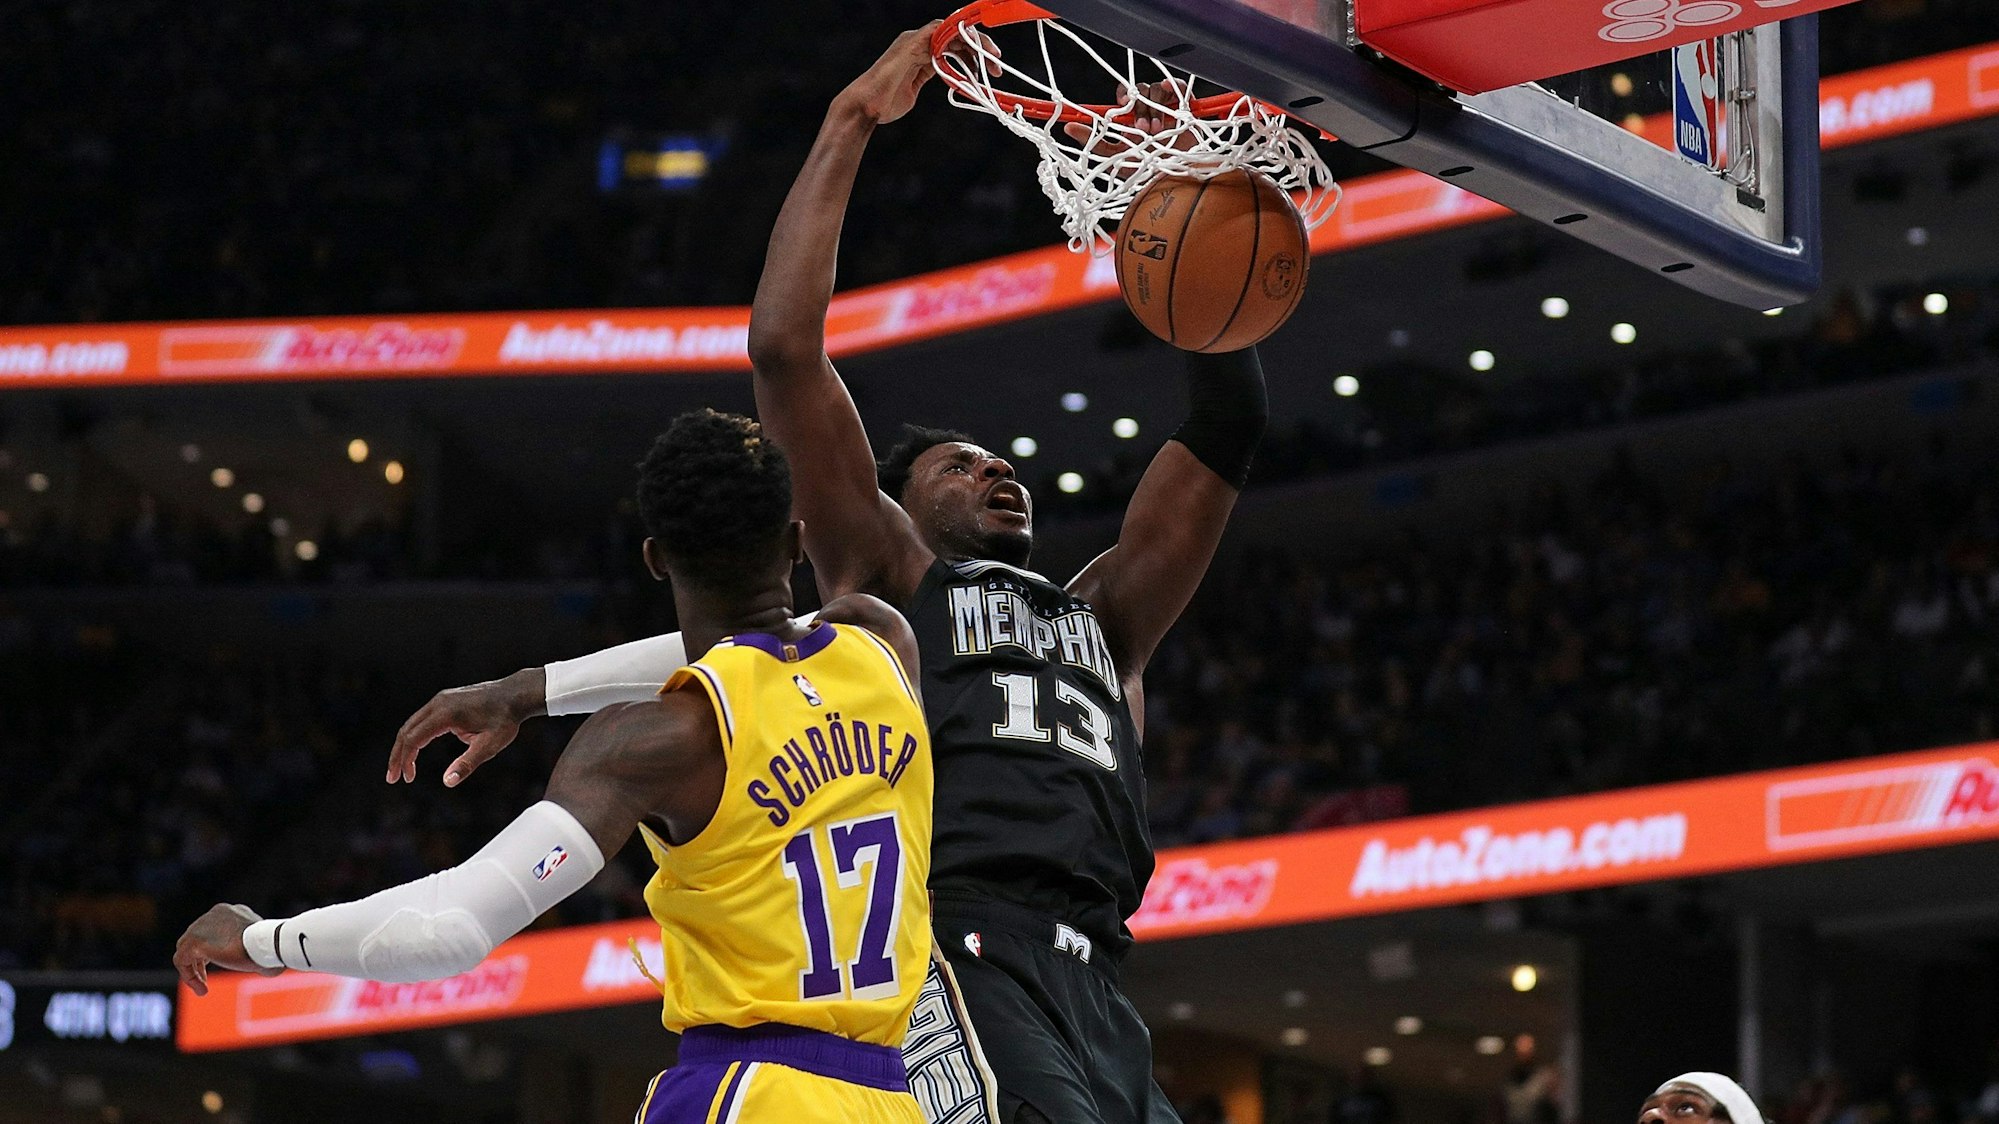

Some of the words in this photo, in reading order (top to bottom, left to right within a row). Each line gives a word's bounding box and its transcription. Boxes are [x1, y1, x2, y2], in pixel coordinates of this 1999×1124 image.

[1681, 120, 1702, 155] NBA
[949, 584, 1121, 702] MEMPHIS
[747, 712, 917, 828] SCHRÖDER
[992, 671, 1118, 772] 13
[1350, 812, 1688, 898] AutoZone.com
[781, 811, 905, 1002] 17
[43, 992, 106, 1038] 4TH
[108, 992, 172, 1043] QTR
